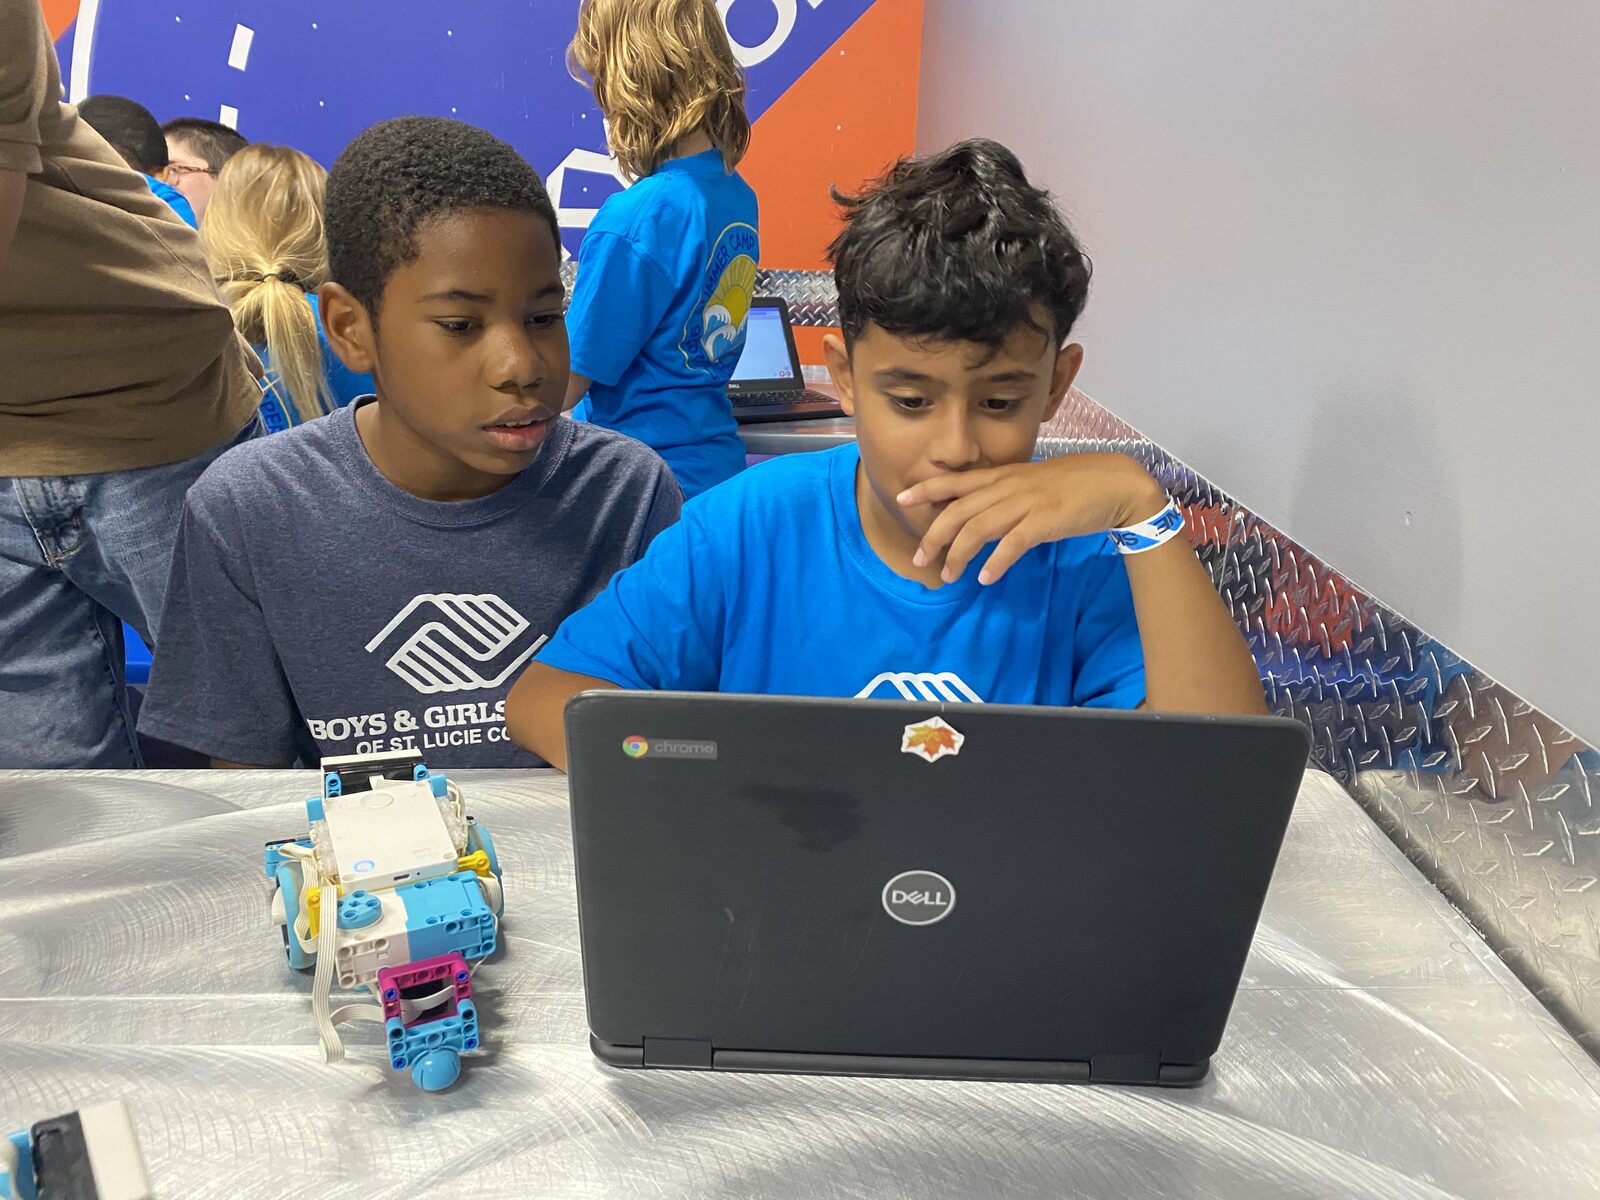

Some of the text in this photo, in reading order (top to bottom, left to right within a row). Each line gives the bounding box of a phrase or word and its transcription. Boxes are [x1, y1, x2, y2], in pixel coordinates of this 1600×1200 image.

[728, 231, 755, 250] CAMP
[306, 700, 506, 741] BOYS & GIRLS
[356, 739, 384, 755] OF
[423, 727, 482, 749] LUCIE
[654, 740, 715, 754] chrome
[891, 889, 948, 906] DELL
